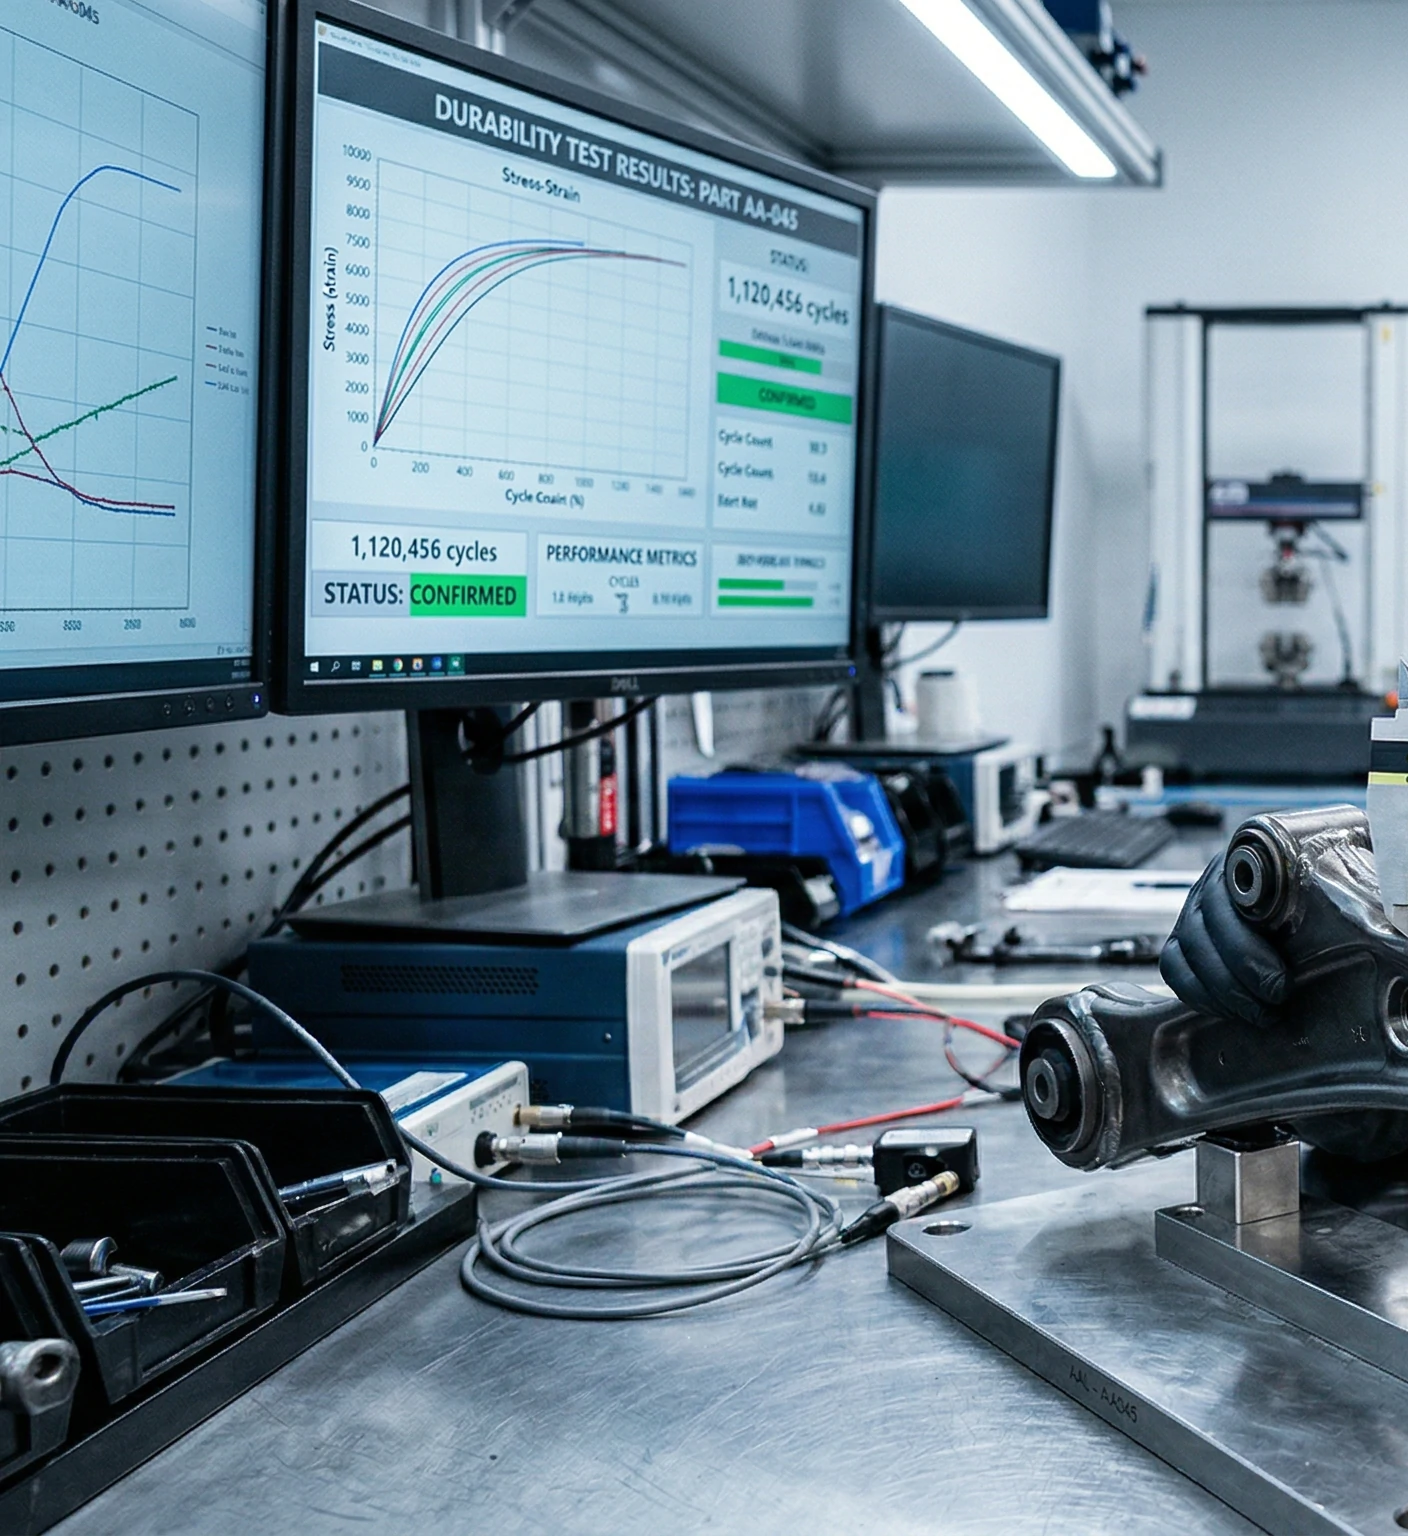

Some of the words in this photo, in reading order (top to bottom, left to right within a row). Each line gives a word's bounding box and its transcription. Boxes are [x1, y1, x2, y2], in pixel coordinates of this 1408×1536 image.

[434, 93, 562, 156] DURABILITY
[566, 136, 612, 173] TEST
[615, 156, 696, 200] RESULTS:
[698, 180, 742, 212] PART
[743, 195, 799, 231] AA-045
[501, 167, 581, 203] Stress-Strain
[345, 203, 371, 220] 8000
[345, 232, 371, 249] 7500
[345, 262, 371, 278] 6000
[345, 292, 370, 307] 5000
[728, 275, 803, 314] 1,120,456
[807, 299, 849, 326] cycles
[323, 303, 336, 352] Stress
[344, 322, 370, 336] 4000
[345, 351, 370, 366] 3000
[345, 380, 369, 395] 2000
[347, 411, 369, 424] 1000
[718, 428, 743, 446] Cycle
[361, 441, 368, 452] 0
[370, 456, 378, 468] 0
[412, 461, 430, 474] 200
[456, 465, 474, 478] 400
[505, 488, 533, 505] Cycle
[351, 535, 441, 562] 1,120,456
[446, 540, 498, 567] cycles
[546, 544, 643, 565] PERFORMANCE
[646, 549, 698, 567] METRICS
[324, 582, 404, 605] STATUS:
[410, 583, 517, 606] CONFIRMED
